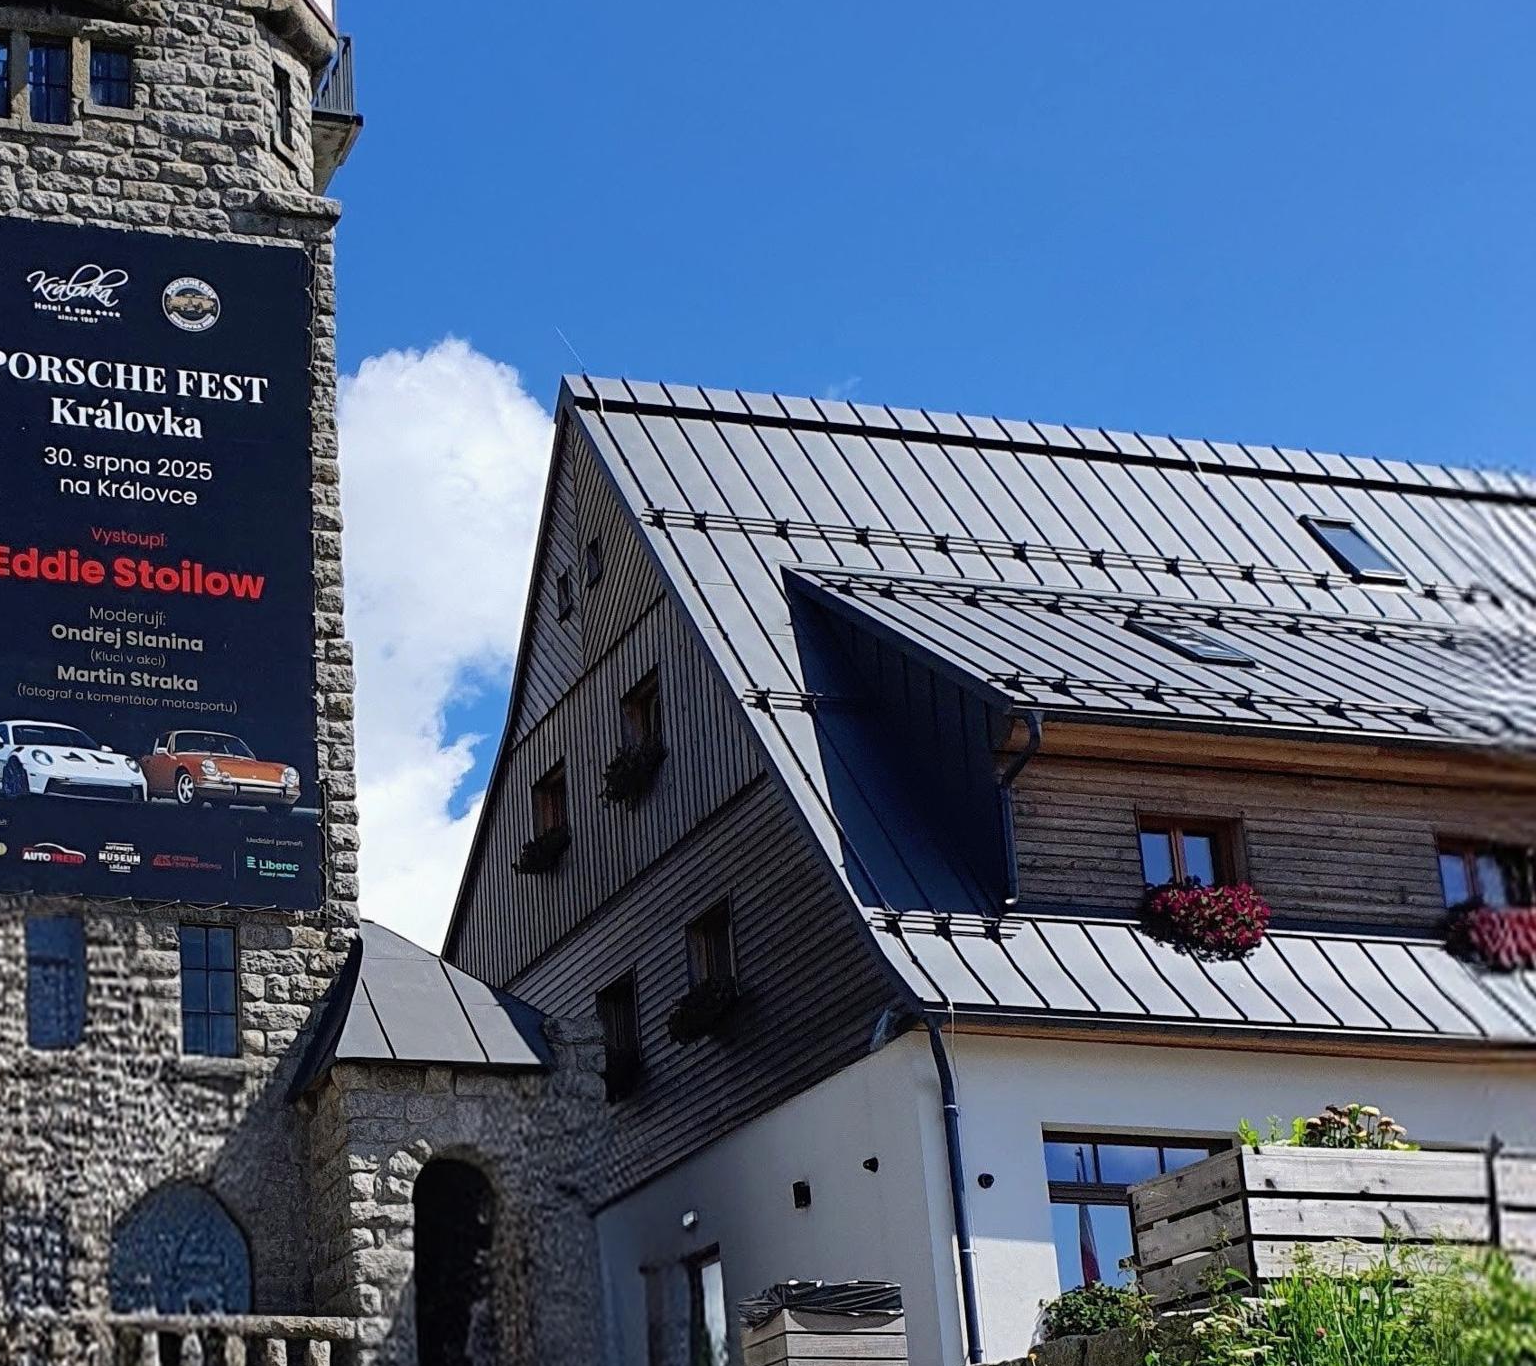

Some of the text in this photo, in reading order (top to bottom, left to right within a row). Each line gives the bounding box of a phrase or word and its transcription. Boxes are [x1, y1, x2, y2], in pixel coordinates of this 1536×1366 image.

[34, 302, 61, 312] Hotel
[176, 369, 269, 404] FEST
[50, 396, 203, 439] Královka
[44, 447, 213, 481] 30. srpna 2025
[60, 477, 198, 506] na Královce
[113, 558, 265, 600] Stoilow
[51, 624, 204, 653] Ondřej Slanina
[90, 649, 166, 669] (Kluci v akci)
[56, 665, 199, 692] Martin Straka
[17, 683, 72, 701] (fotograf
[75, 692, 84, 700] a
[161, 696, 238, 714] motosportu)
[98, 852, 141, 864] MUSEUM
[259, 859, 300, 872] Liberec
